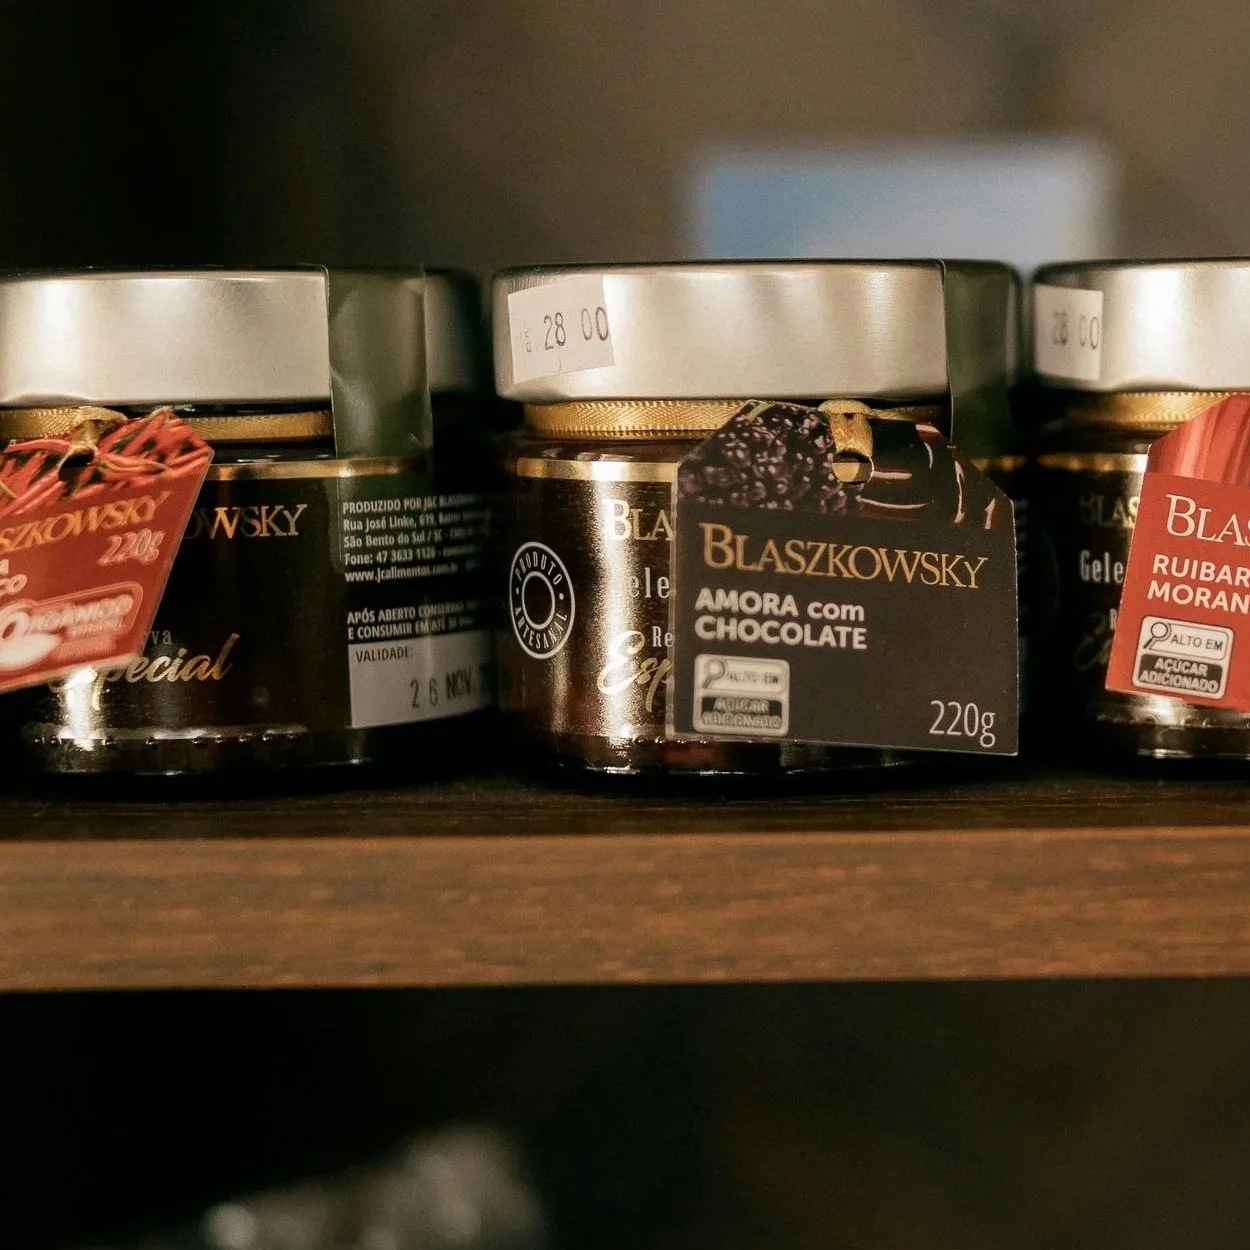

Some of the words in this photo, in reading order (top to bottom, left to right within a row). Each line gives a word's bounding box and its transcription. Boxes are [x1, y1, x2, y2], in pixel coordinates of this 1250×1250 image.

[543, 312, 566, 350] 28
[581, 306, 609, 341] 00
[343, 498, 401, 514] PRODUZIDO
[403, 496, 422, 511] POR
[343, 519, 363, 531] Rua
[365, 516, 387, 533] José
[343, 535, 363, 548] São
[365, 533, 395, 547] Bento
[397, 532, 409, 545] do
[411, 530, 426, 545] Sul
[97, 528, 166, 565] 220g
[344, 552, 373, 566] Fone:
[376, 550, 388, 563] 47
[699, 522, 988, 589] BLASZKOWSKY
[514, 551, 563, 587] PRODUTO
[347, 607, 376, 625] APÓS
[378, 605, 416, 621] ABERTO
[694, 587, 799, 617] AMORA
[807, 601, 864, 622] com
[357, 623, 413, 639] CONSUMIR
[514, 606, 568, 651] ARTESANAL
[694, 615, 868, 650] CHOCOLATE
[1171, 634, 1202, 647] ALTO
[1206, 640, 1224, 651] EM
[1139, 670, 1219, 693] ADICIONADO
[929, 700, 996, 747] 220g
